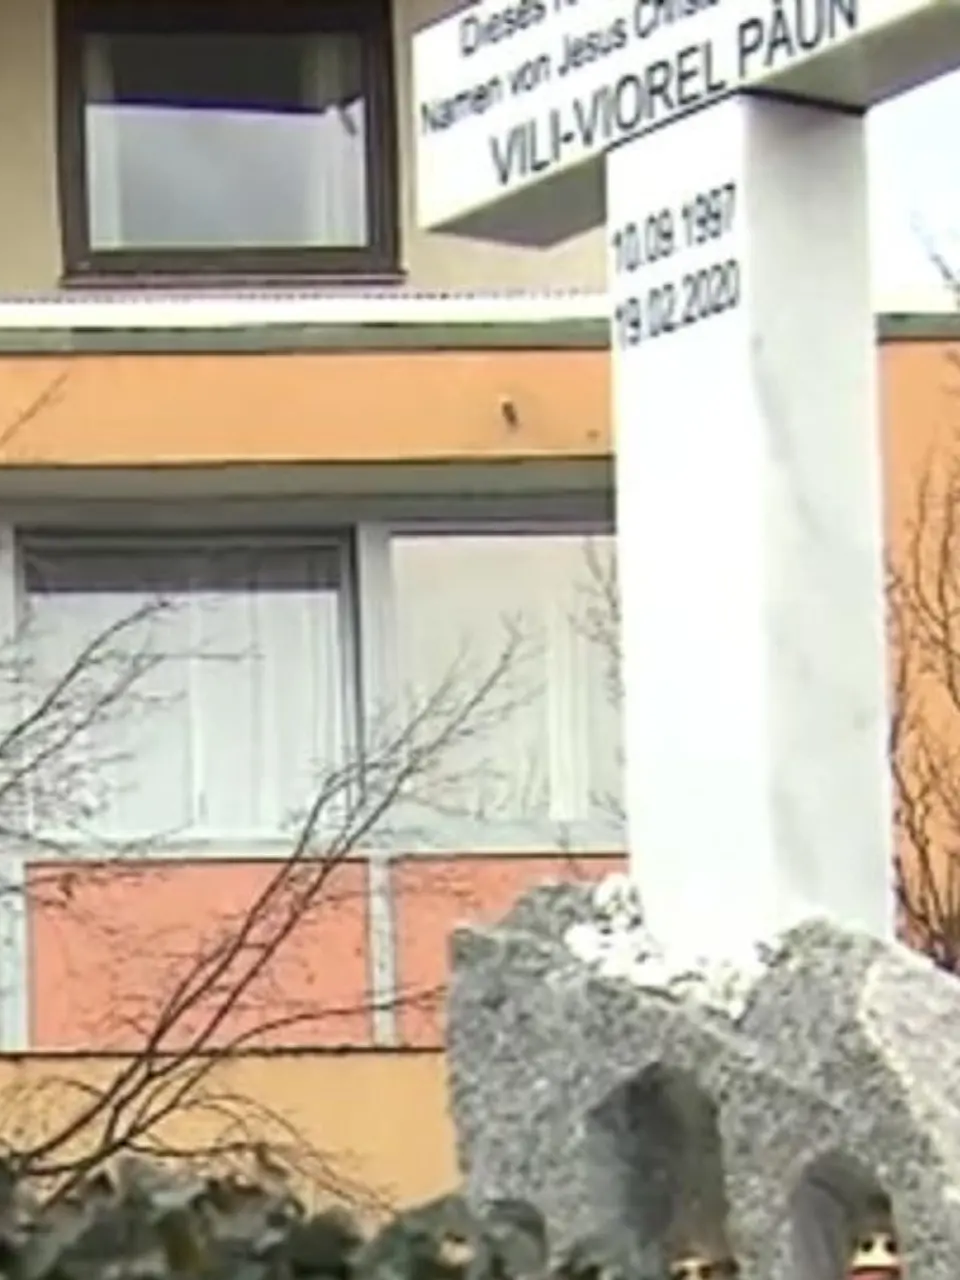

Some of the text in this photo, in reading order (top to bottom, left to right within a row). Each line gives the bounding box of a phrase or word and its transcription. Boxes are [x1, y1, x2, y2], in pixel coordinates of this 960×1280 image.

[421, 76, 503, 134] Namen
[511, 54, 551, 94] von
[558, 18, 627, 77] Jesus
[460, 0, 546, 57] Dieses
[489, 39, 726, 185] VILI-VIOREL
[615, 258, 740, 351] 19.02.2020
